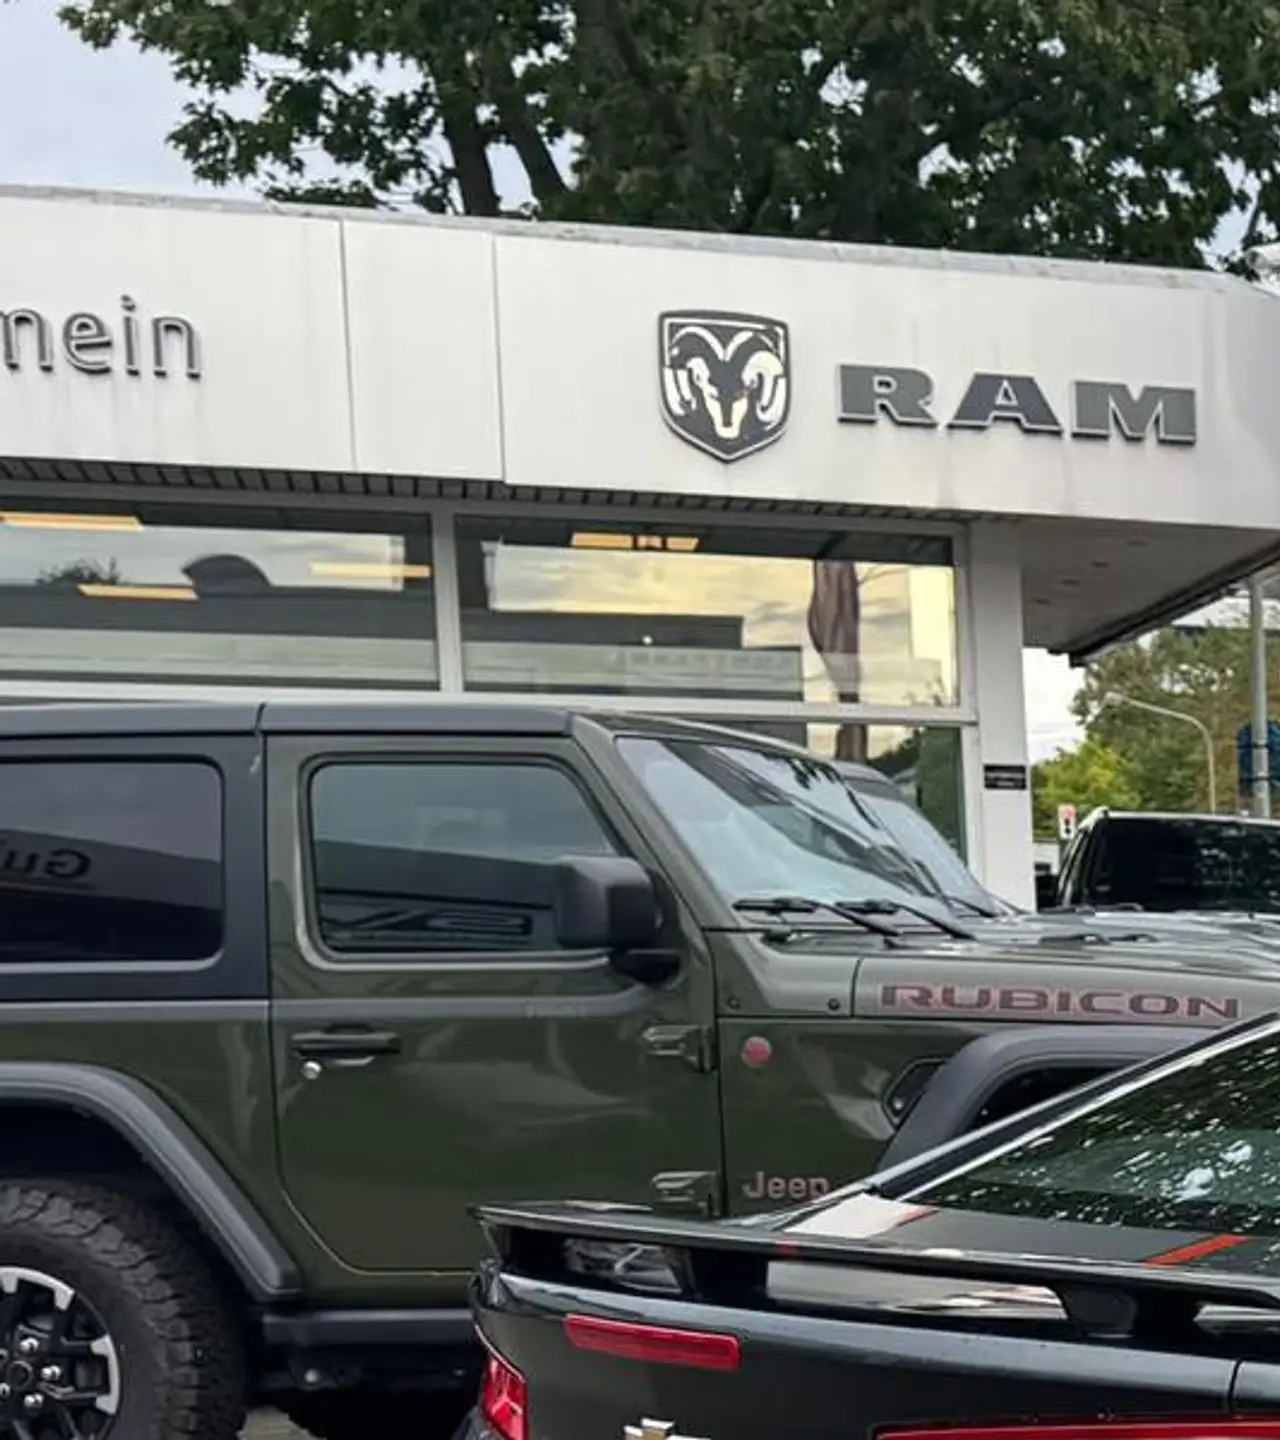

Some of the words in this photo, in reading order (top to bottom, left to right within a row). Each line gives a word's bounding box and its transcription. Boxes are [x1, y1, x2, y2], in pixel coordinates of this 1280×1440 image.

[837, 364, 1197, 444] RAM
[879, 984, 1239, 1020] RUBICON
[742, 1170, 830, 1200] Jeep
